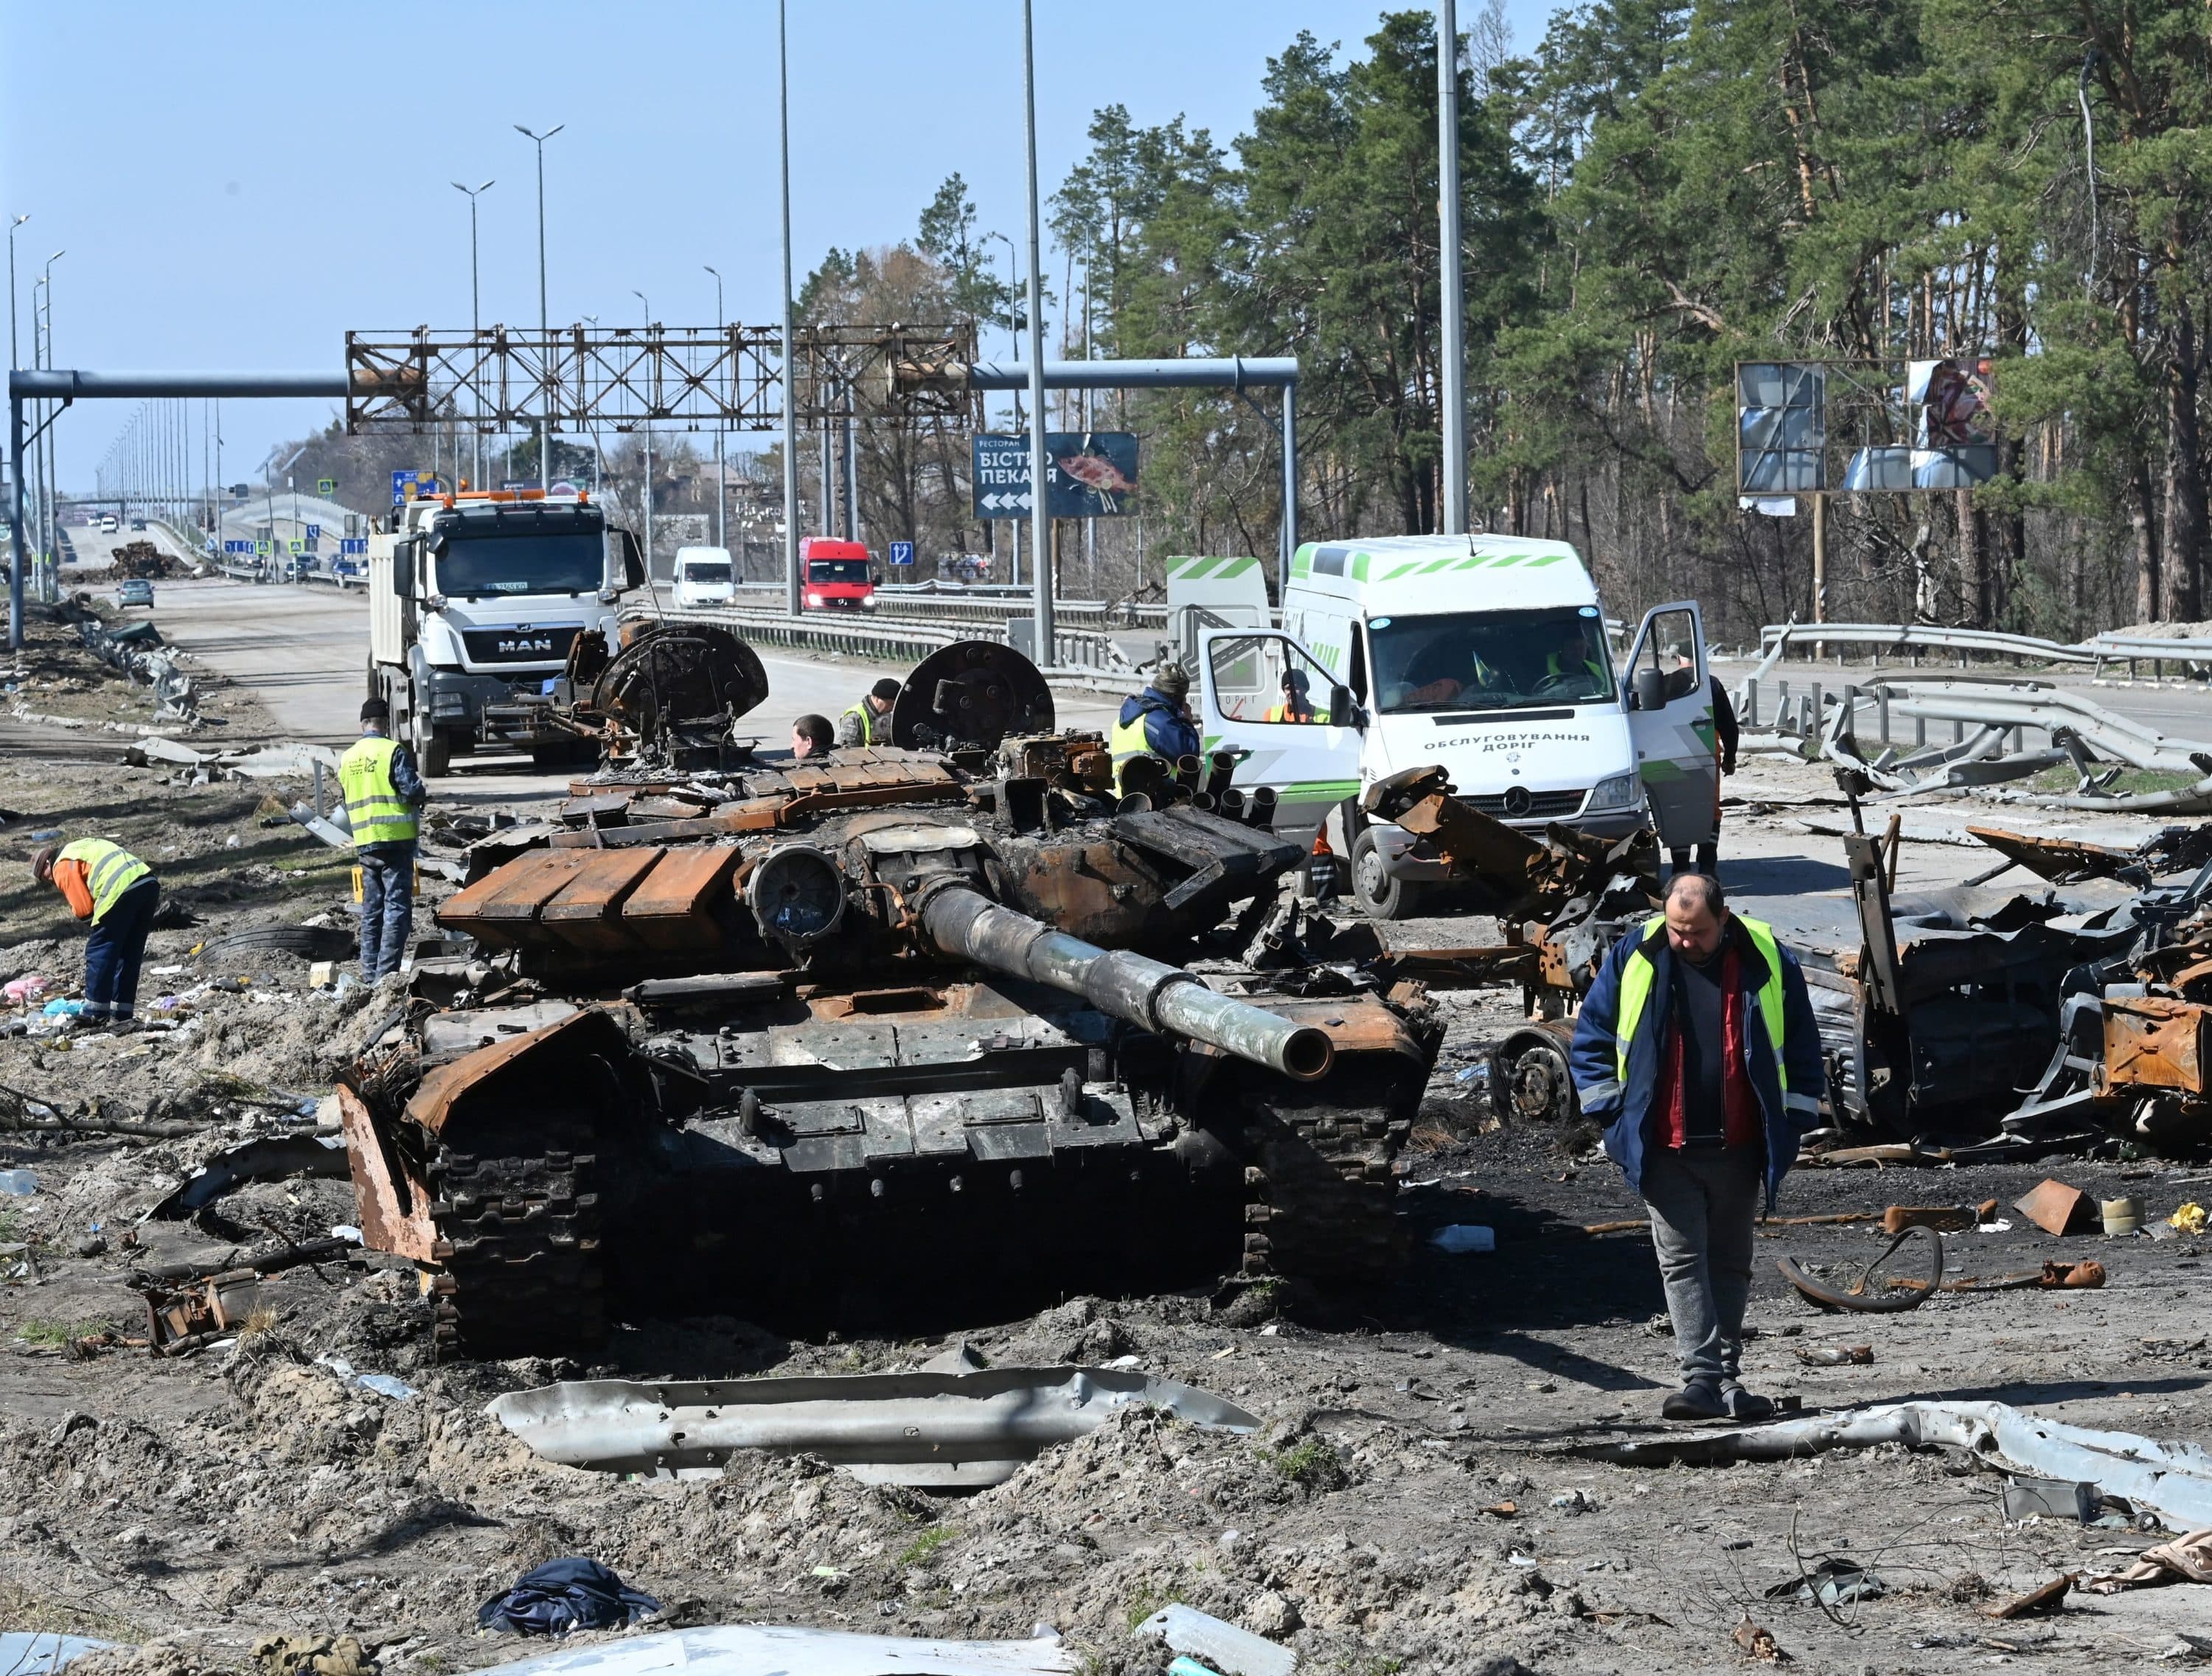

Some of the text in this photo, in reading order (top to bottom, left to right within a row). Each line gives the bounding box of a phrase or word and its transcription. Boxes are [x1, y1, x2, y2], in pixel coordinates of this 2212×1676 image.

[981, 468, 1057, 484] ПЕКАЯ
[498, 639, 552, 653] MAN
[1424, 734, 1590, 750] ОБСЛУГОВУВАННЯ
[1482, 742, 1536, 752] ДОРІГ
